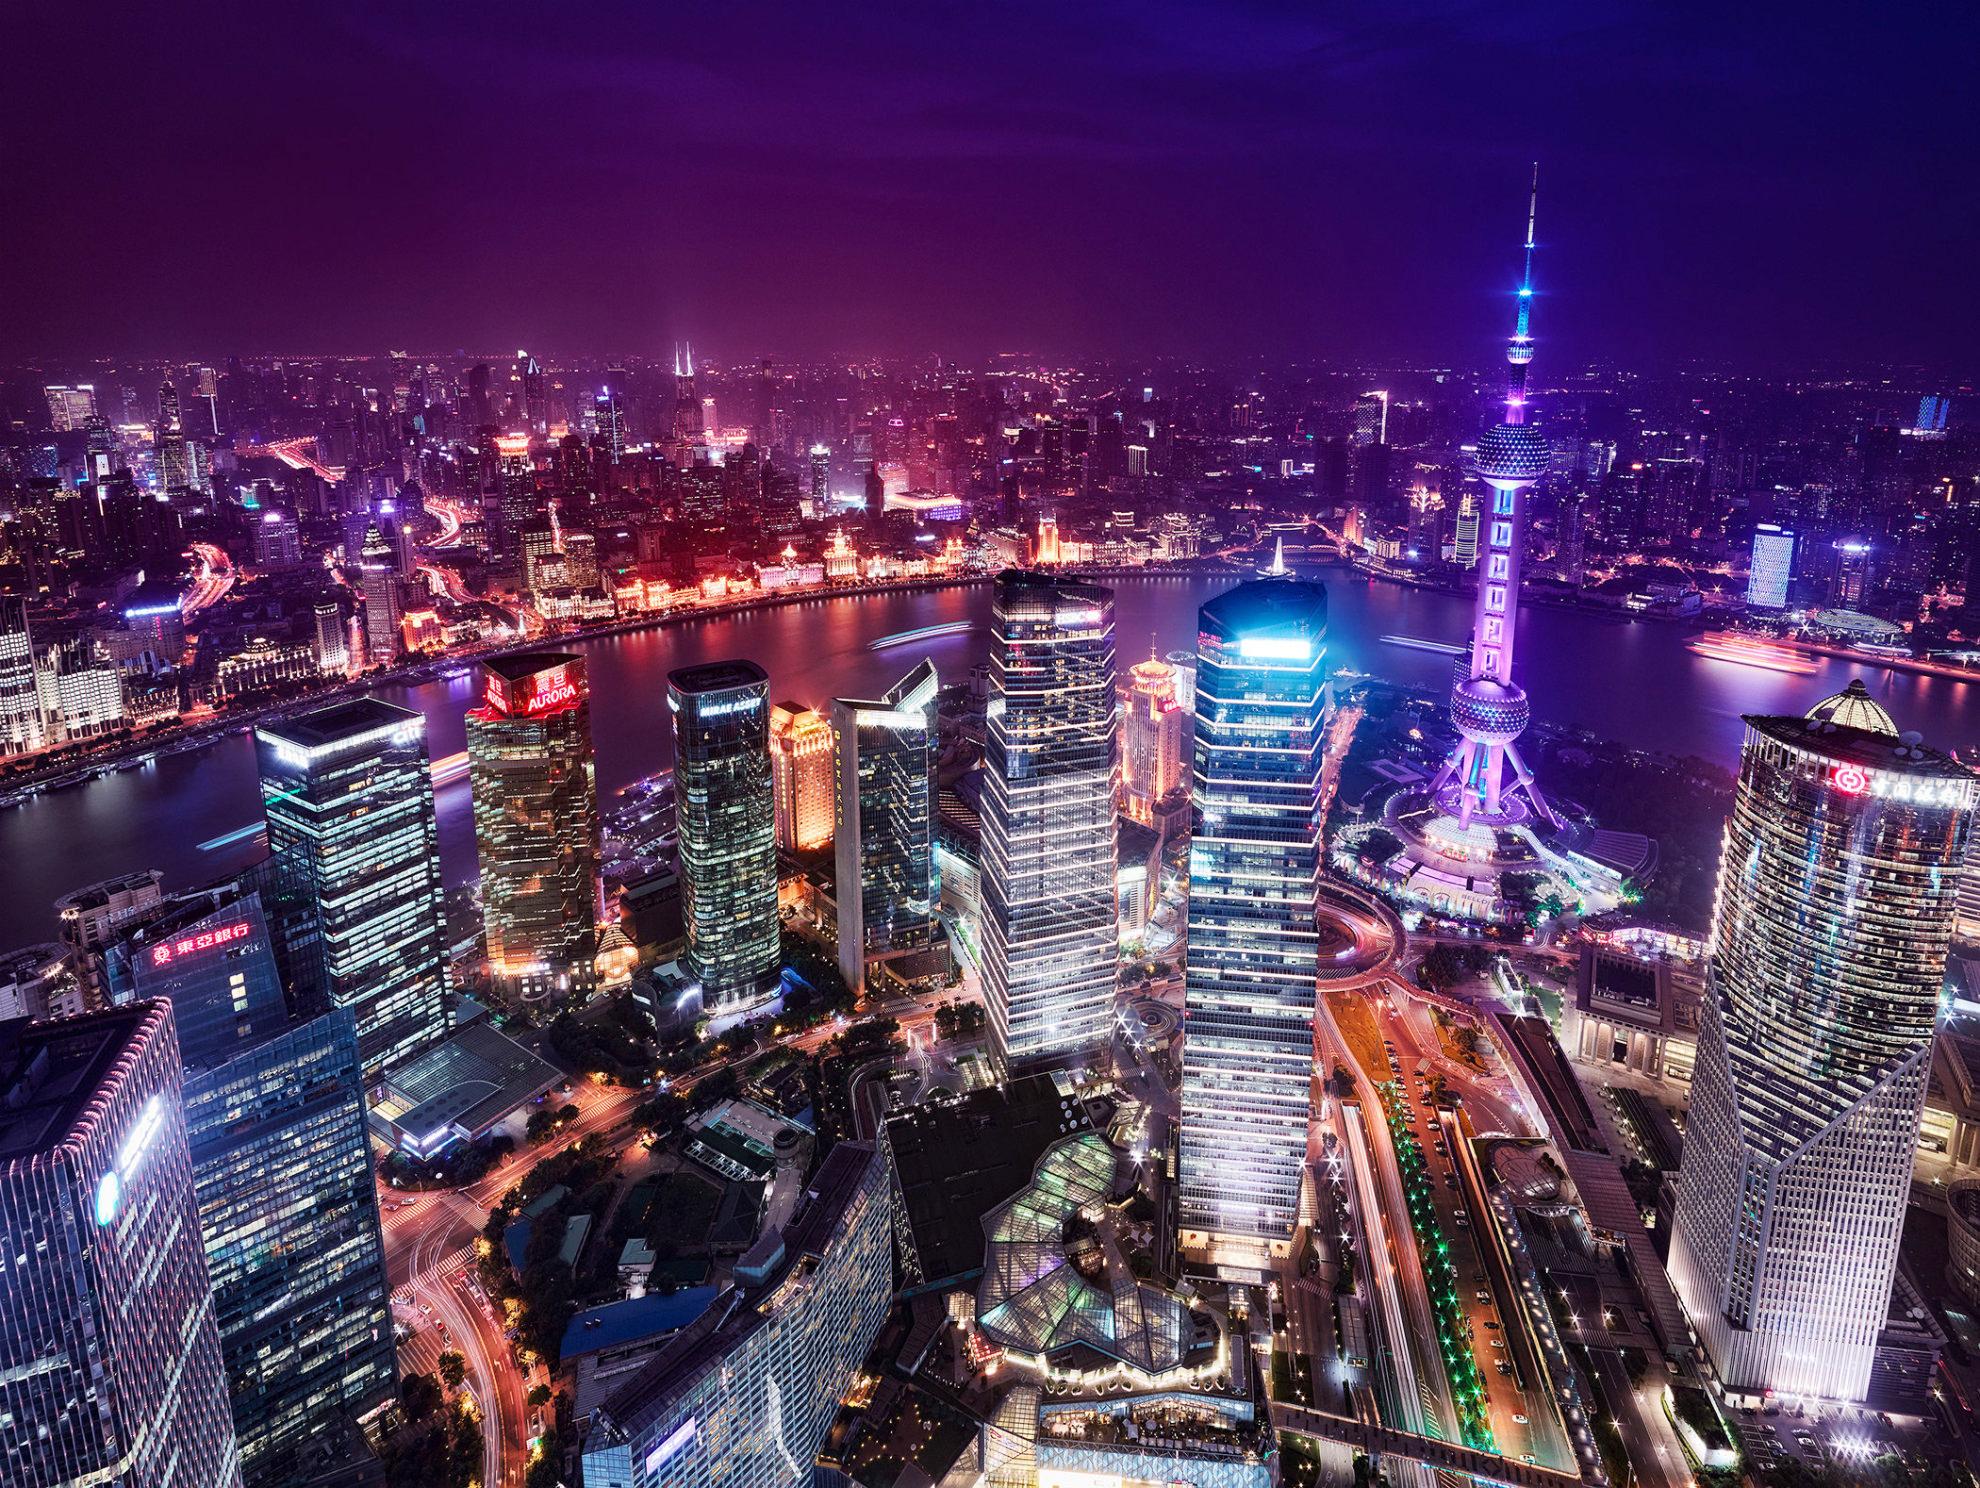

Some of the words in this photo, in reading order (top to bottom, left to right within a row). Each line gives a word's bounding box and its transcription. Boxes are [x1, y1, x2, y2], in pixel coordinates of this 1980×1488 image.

[536, 671, 567, 694] 震旦
[528, 684, 576, 712] AURORA
[700, 703, 733, 717] MIRAE
[177, 923, 249, 955] 東亞銀行
